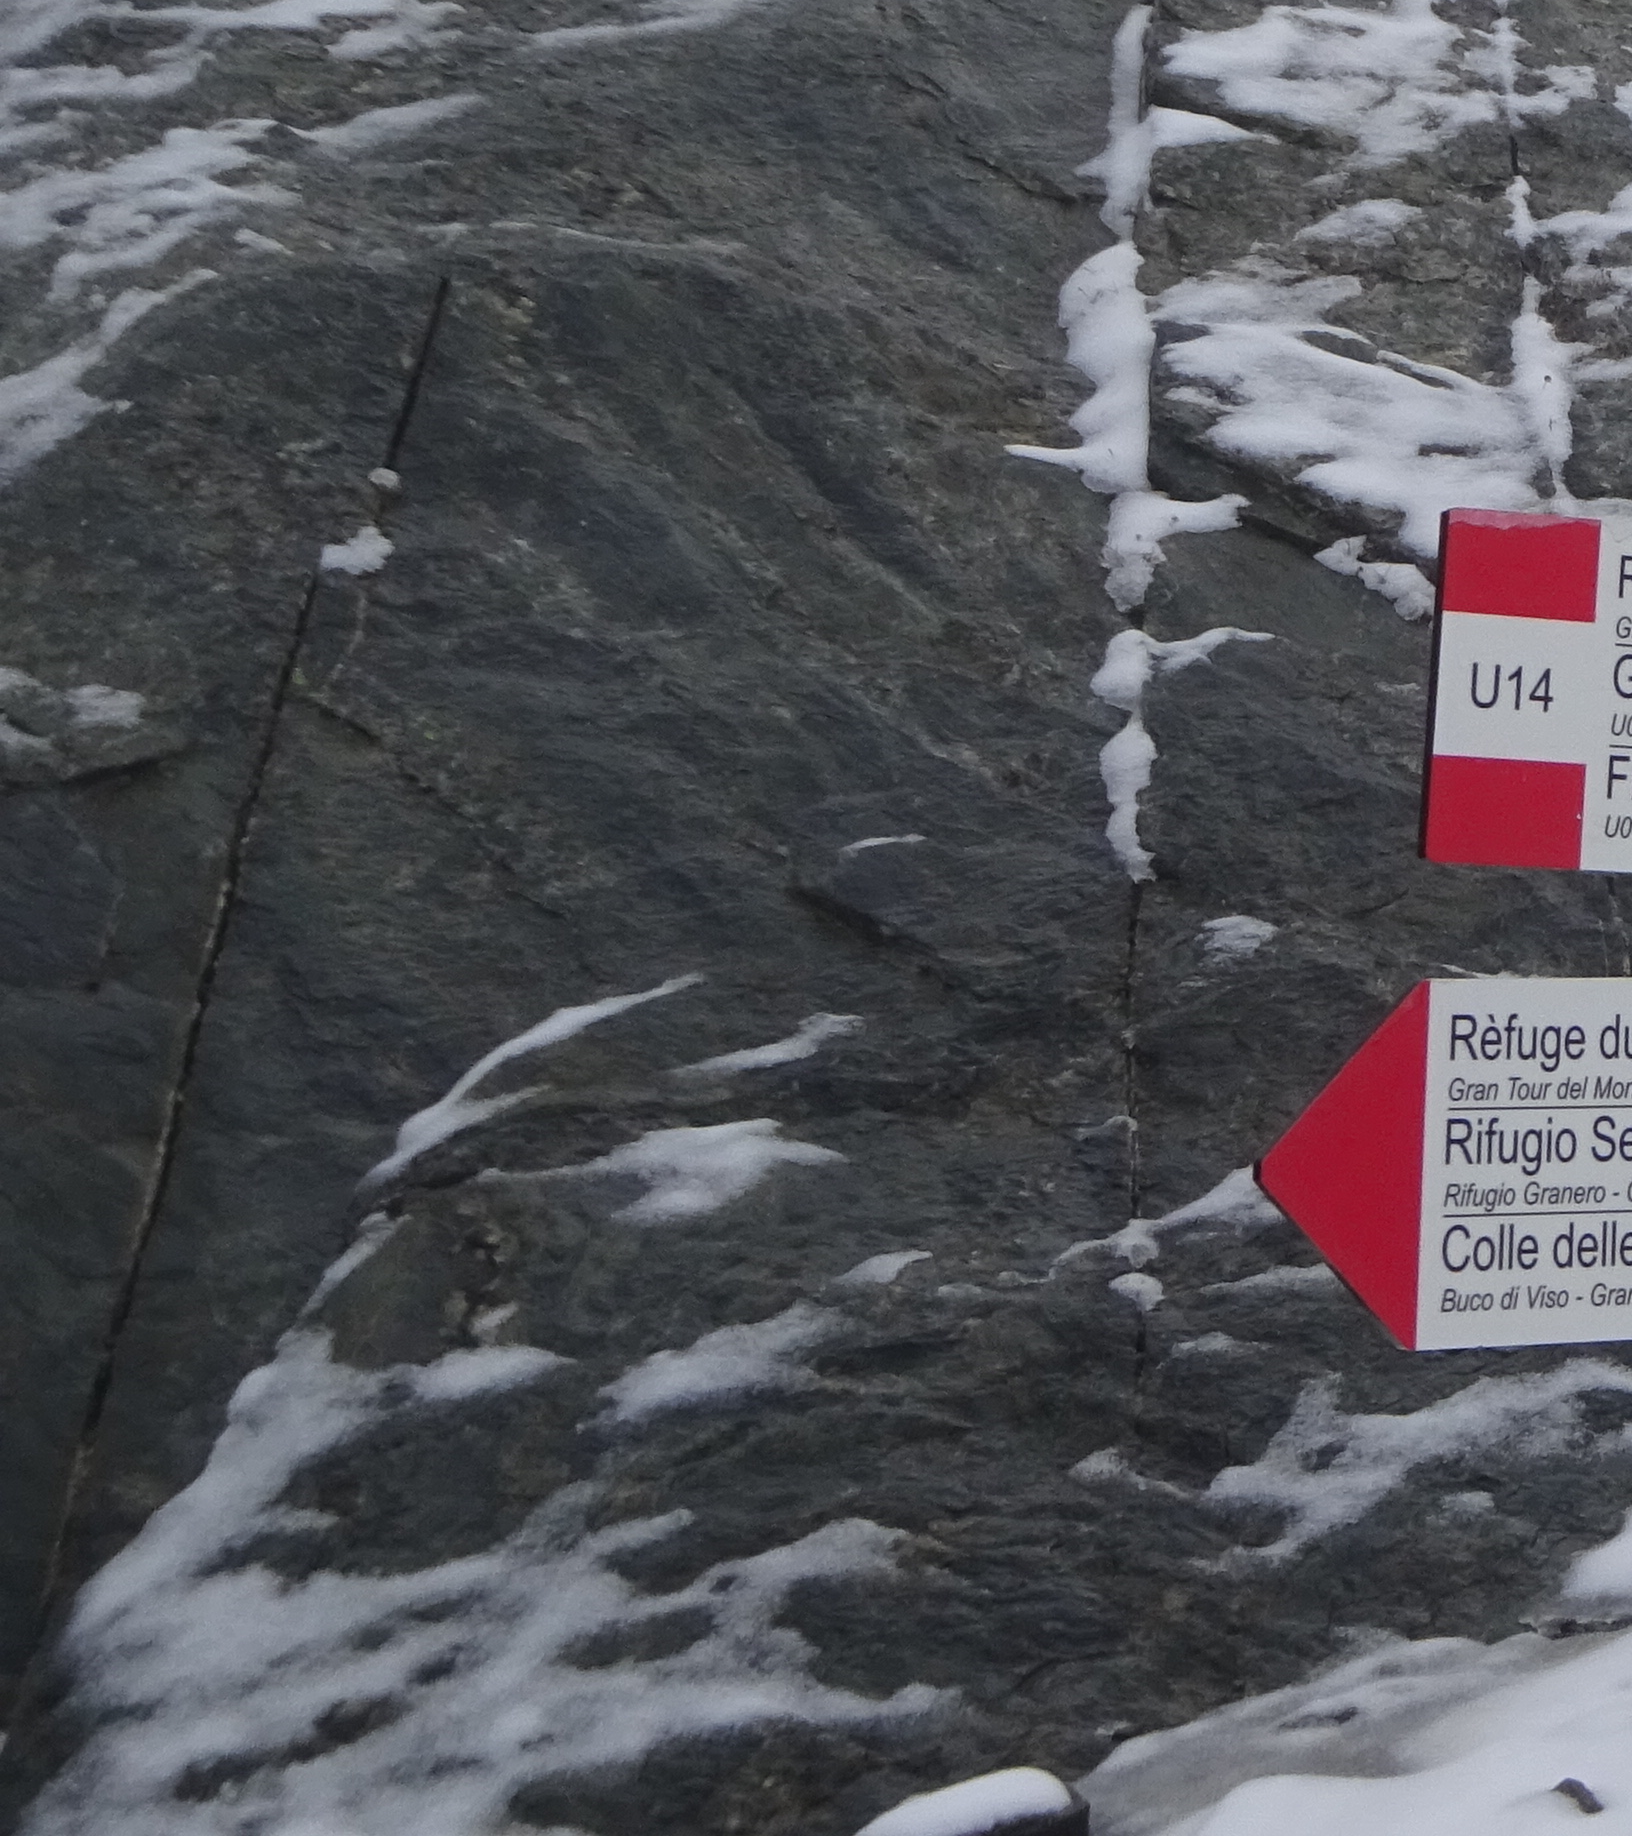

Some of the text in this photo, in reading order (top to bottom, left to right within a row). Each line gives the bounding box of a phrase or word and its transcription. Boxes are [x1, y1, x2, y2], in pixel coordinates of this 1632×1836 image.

[1470, 662, 1554, 713] U14
[1449, 1012, 1586, 1073] Rèfuge
[1448, 1077, 1499, 1102] Gran
[1508, 1076, 1553, 1101] Tour
[1556, 1076, 1589, 1100] del
[1444, 1116, 1578, 1177] Rifugio
[1443, 1182, 1516, 1213] Rifugio
[1523, 1181, 1607, 1206] Granero
[1441, 1223, 1539, 1273] Colle
[1440, 1288, 1494, 1313] Buco
[1500, 1286, 1520, 1311] di
[1527, 1285, 1570, 1310] Viso
